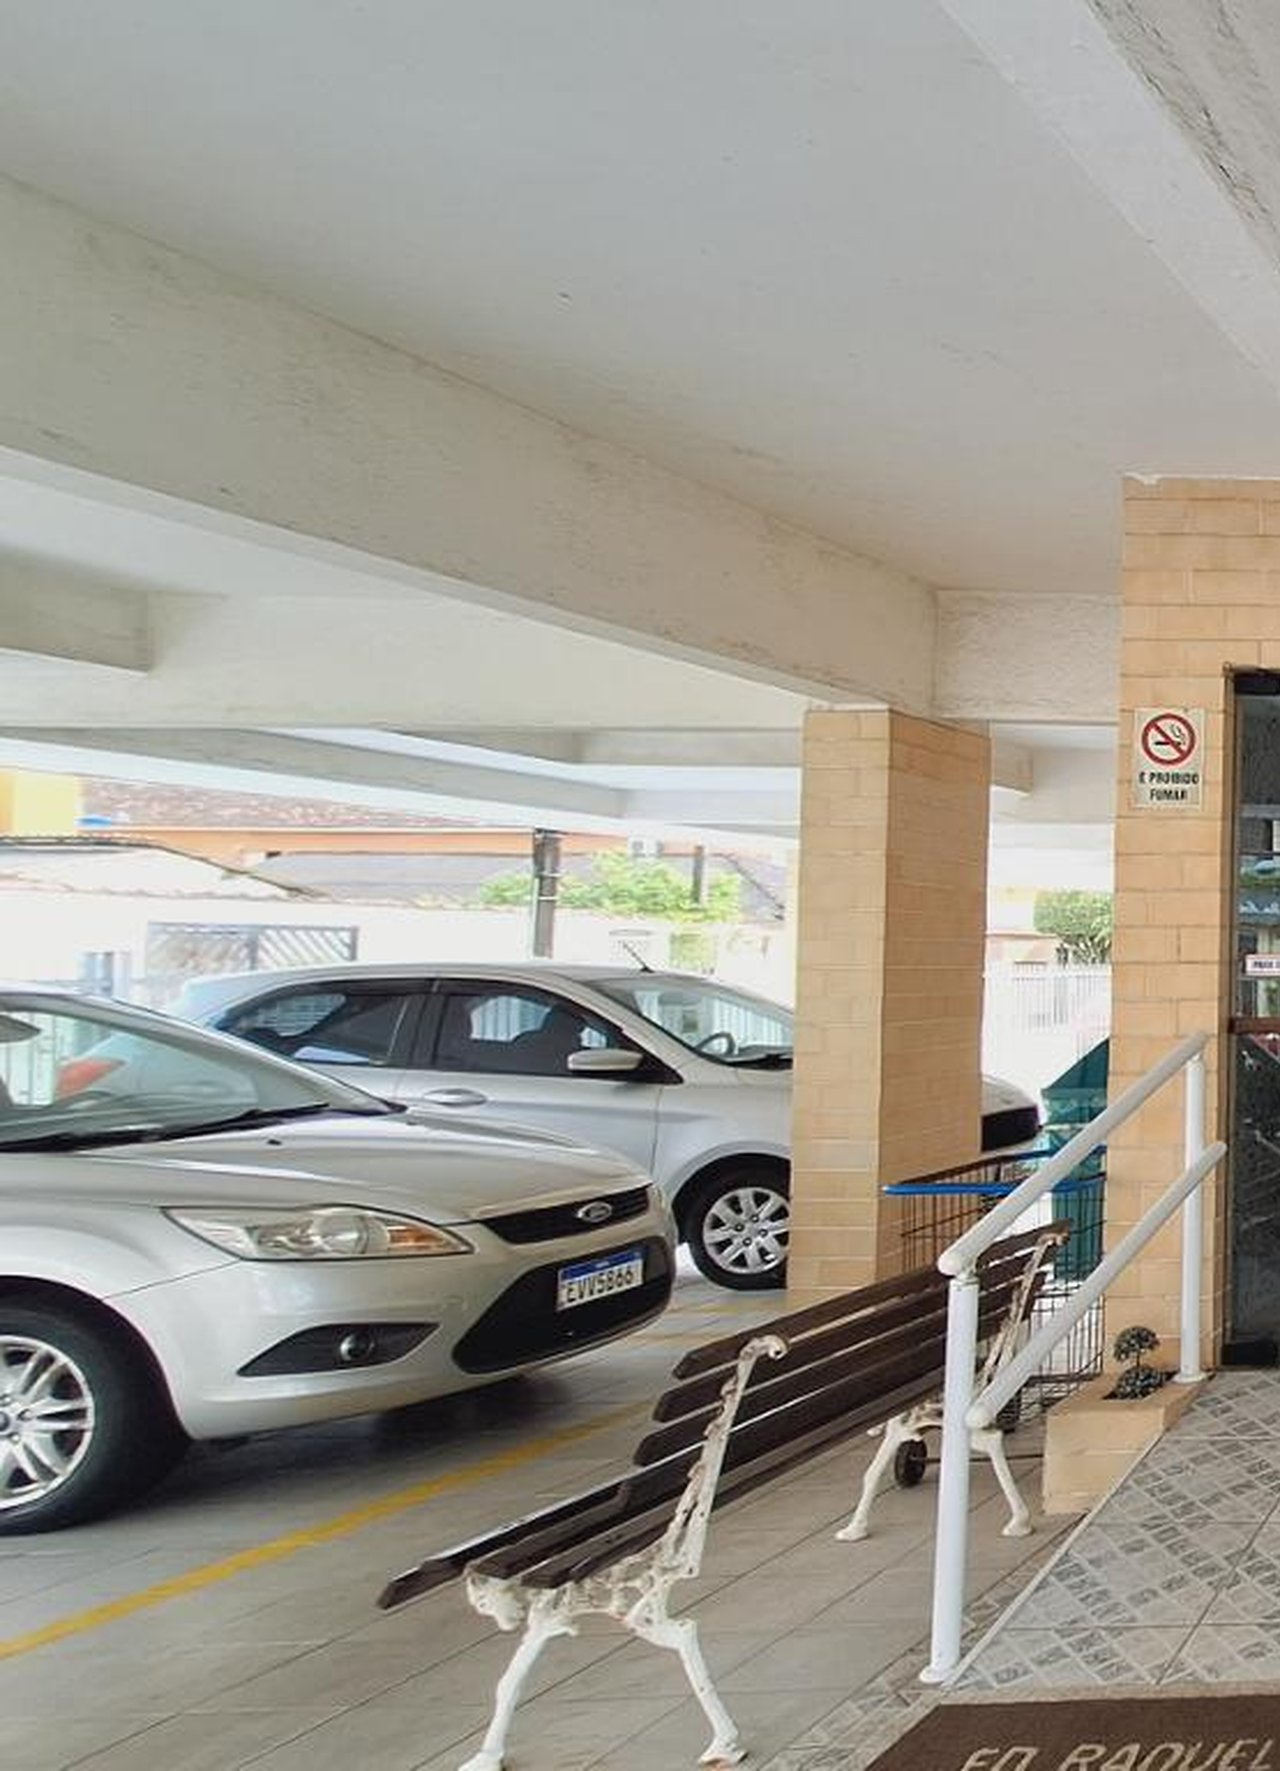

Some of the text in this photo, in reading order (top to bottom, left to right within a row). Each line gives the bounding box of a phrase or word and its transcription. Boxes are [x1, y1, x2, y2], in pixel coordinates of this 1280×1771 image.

[1149, 771, 1200, 784] PROIBIDO
[1149, 788, 1188, 801] FUMAR
[1057, 1739, 1274, 1771] RAQUEL
